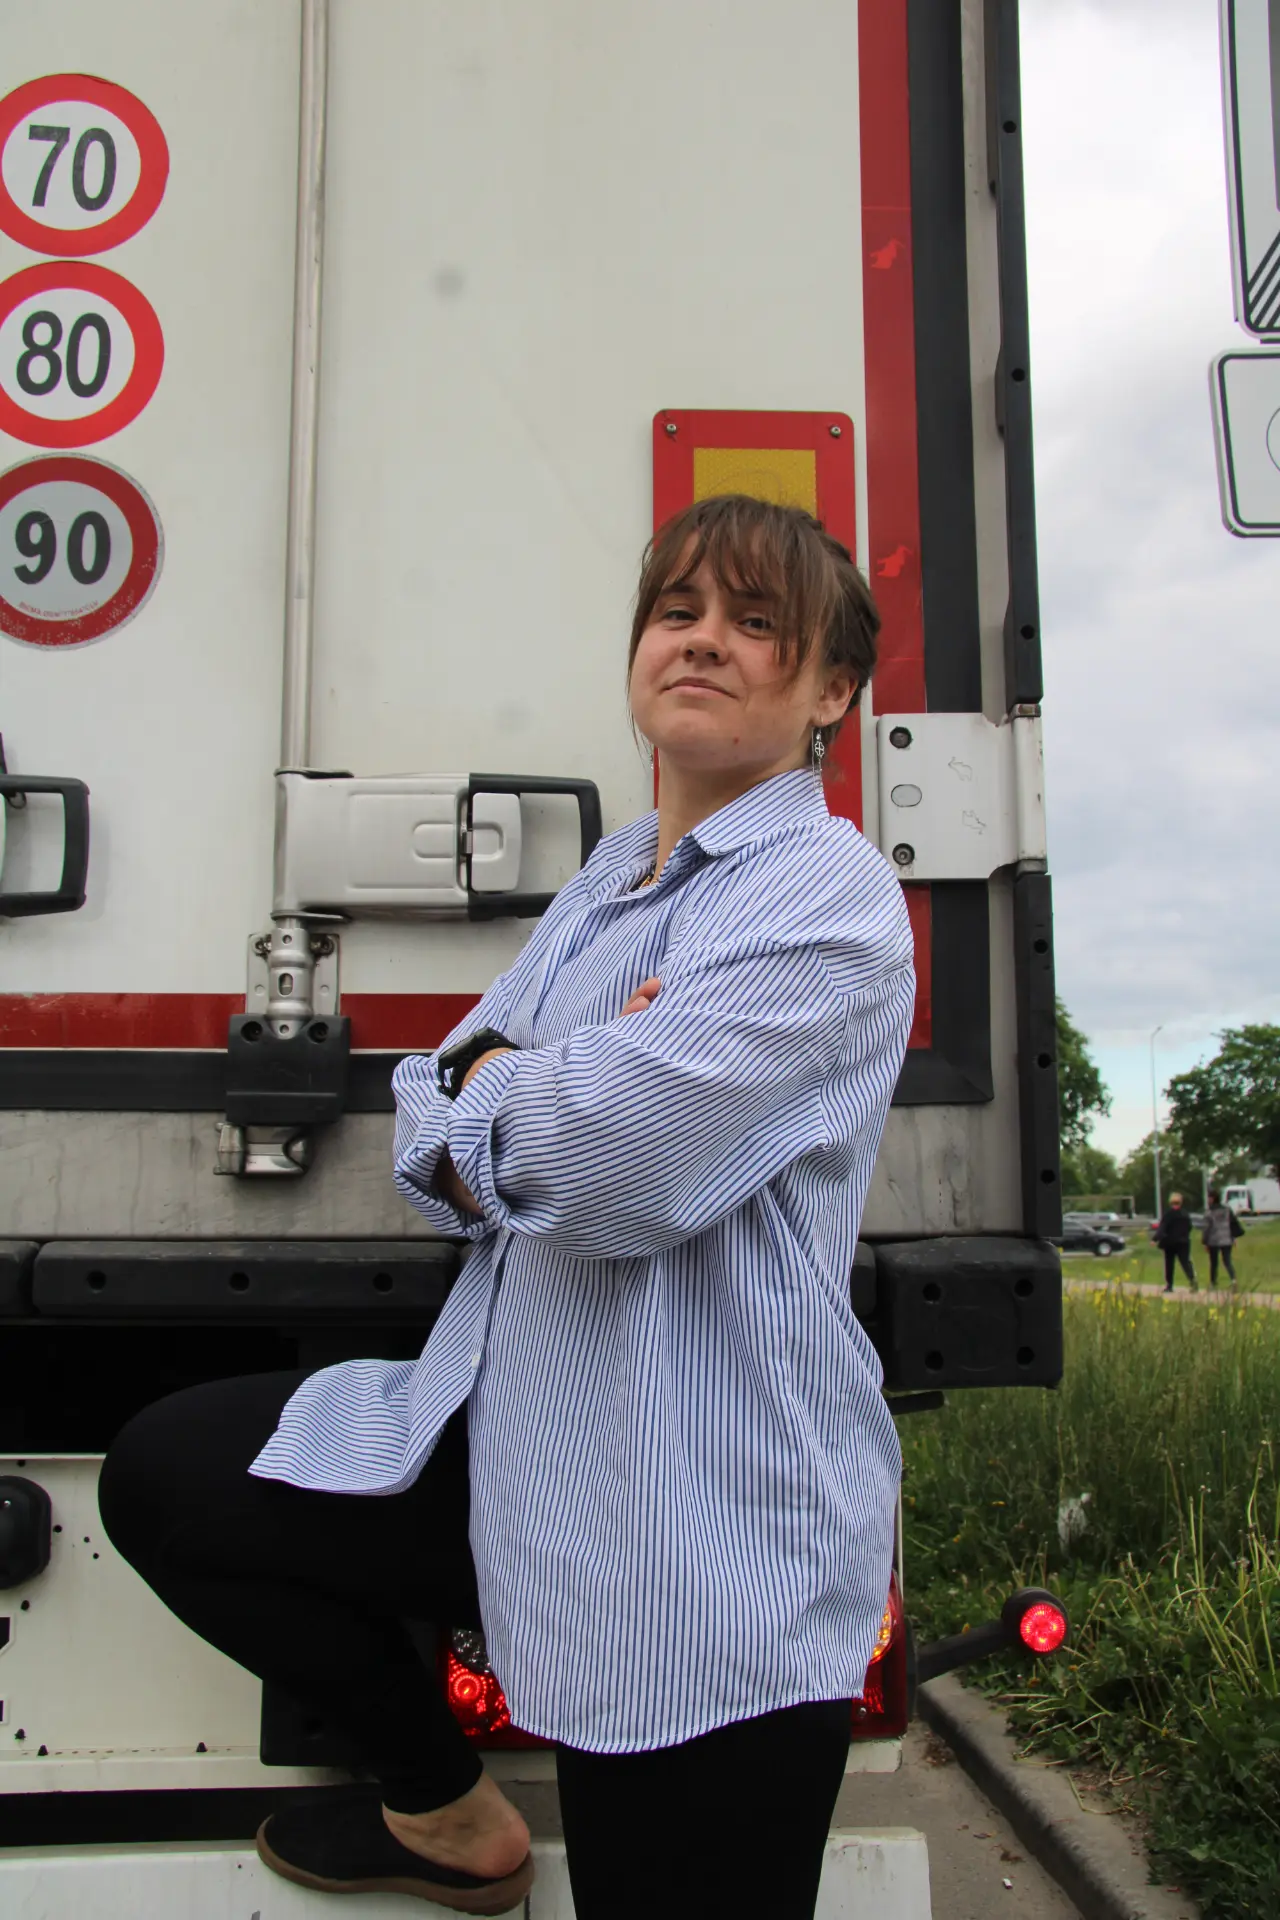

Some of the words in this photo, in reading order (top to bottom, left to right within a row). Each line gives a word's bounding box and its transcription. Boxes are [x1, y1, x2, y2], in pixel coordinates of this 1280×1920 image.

[28, 124, 117, 211] 70
[16, 310, 112, 398] 80
[14, 510, 112, 586] 90
